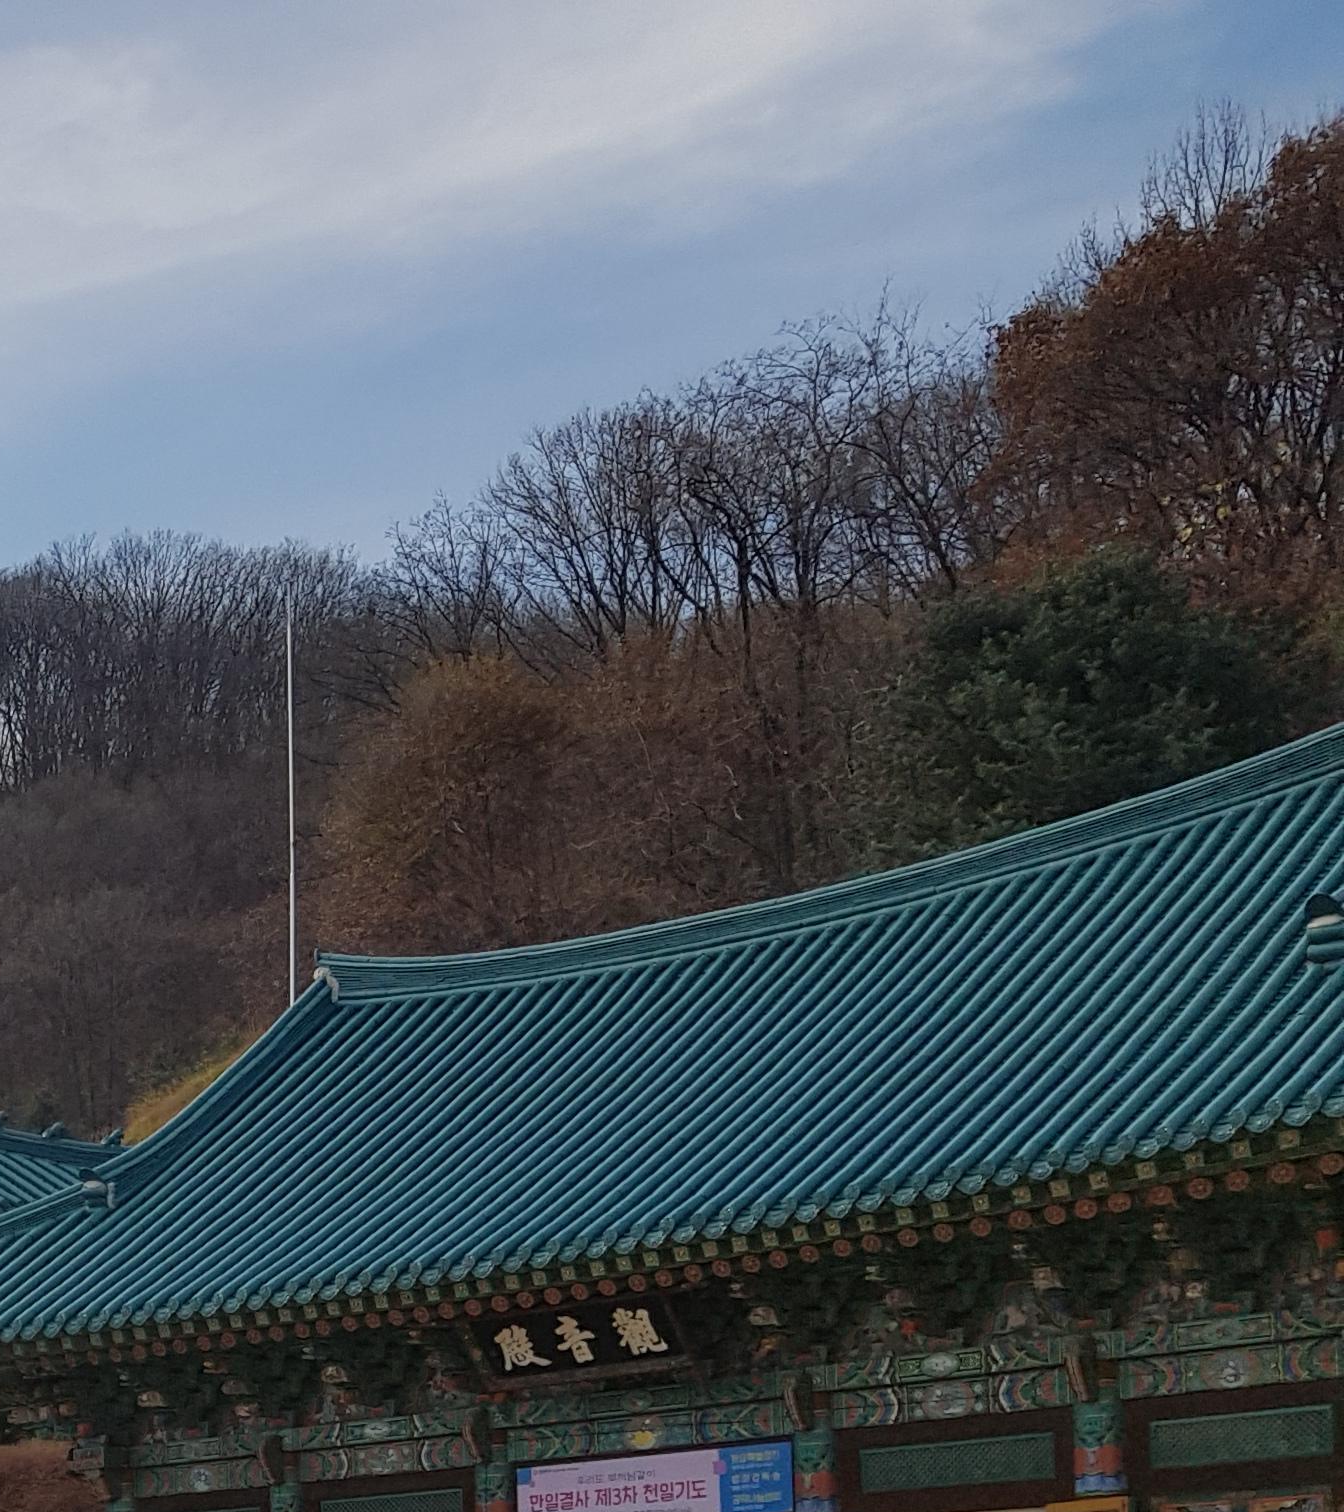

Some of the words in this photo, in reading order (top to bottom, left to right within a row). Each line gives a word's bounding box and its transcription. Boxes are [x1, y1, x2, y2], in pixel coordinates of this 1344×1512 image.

[494, 1307, 669, 1371] 觀音殿
[529, 1491, 590, 1512] 만일결사
[595, 1485, 638, 1507] 제3차
[643, 1480, 708, 1504] 천일기도
